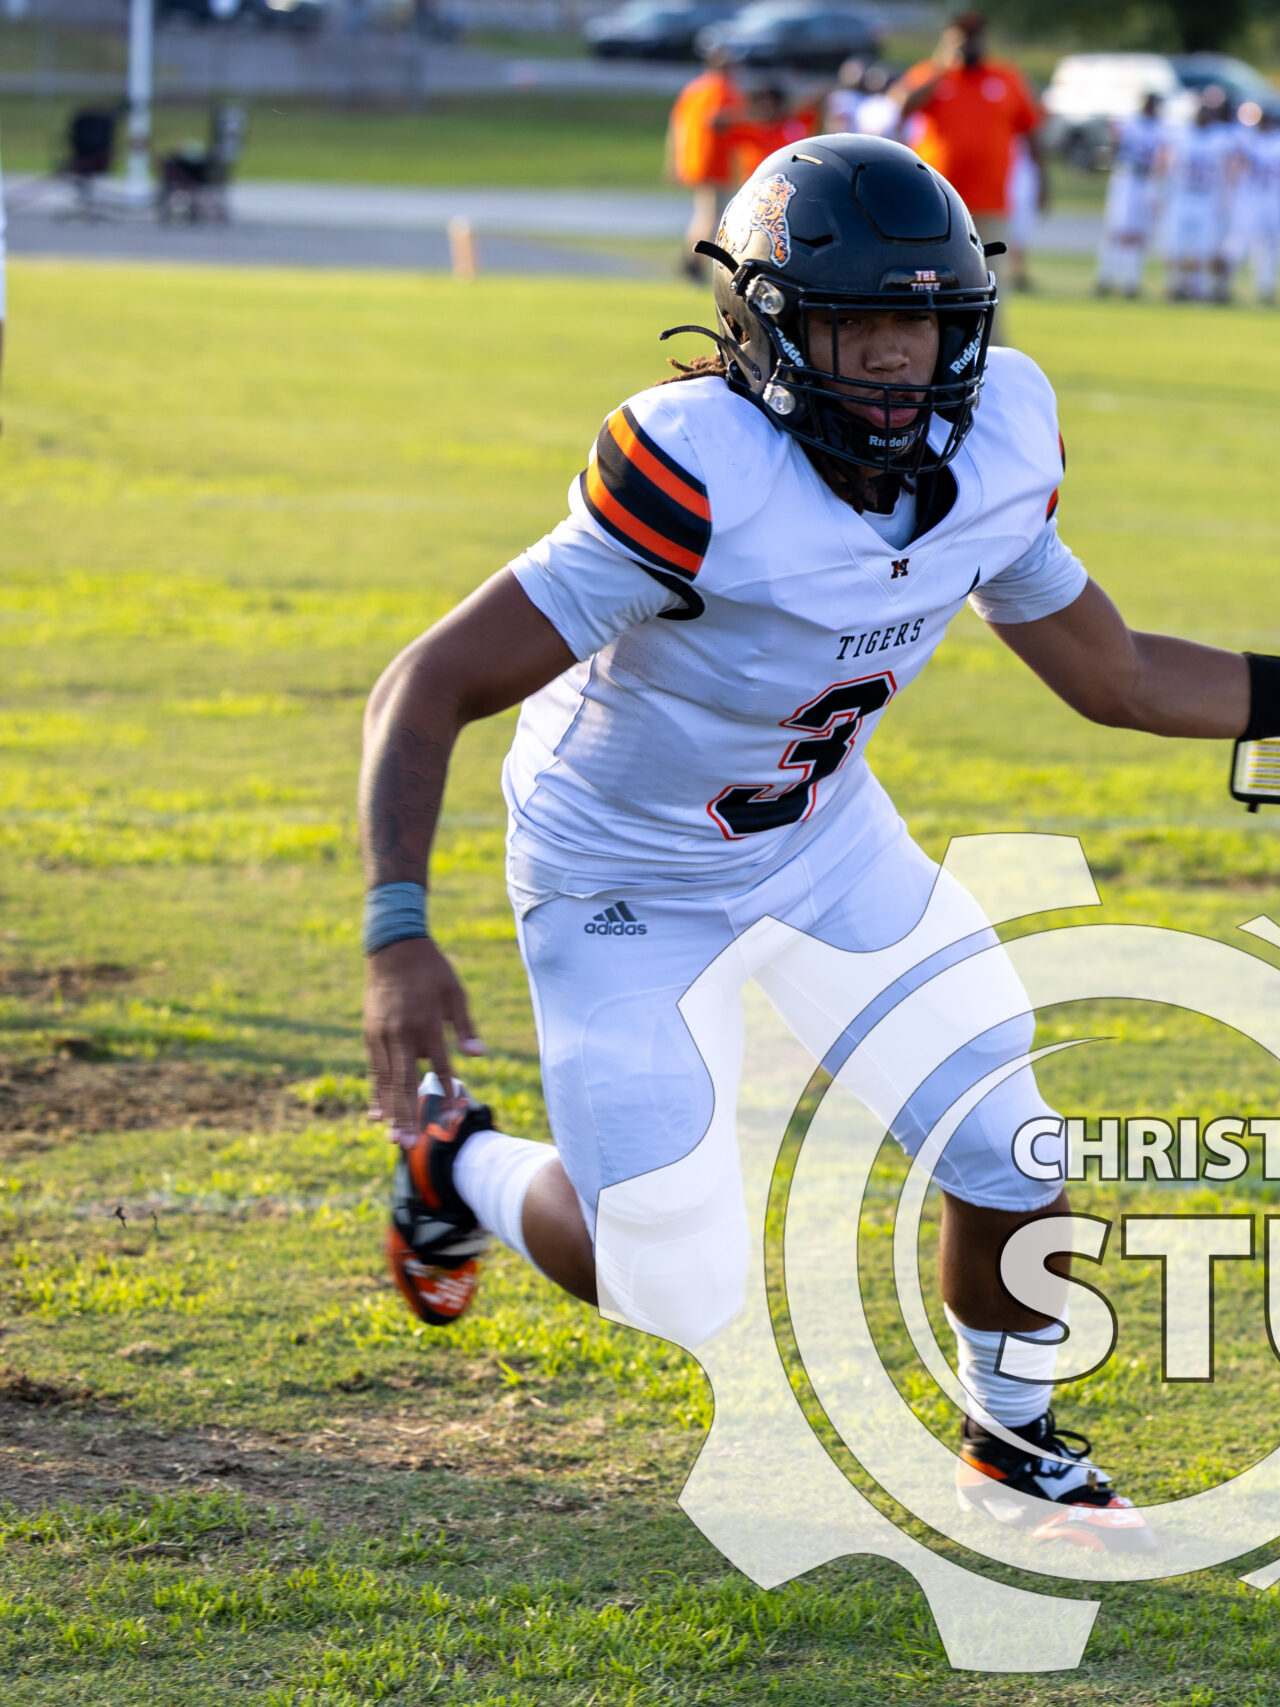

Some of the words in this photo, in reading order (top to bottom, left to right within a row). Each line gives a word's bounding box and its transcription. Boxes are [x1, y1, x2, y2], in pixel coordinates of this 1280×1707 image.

[836, 617, 925, 661] TIGERS
[706, 670, 898, 841] 3
[584, 918, 648, 937] adidas
